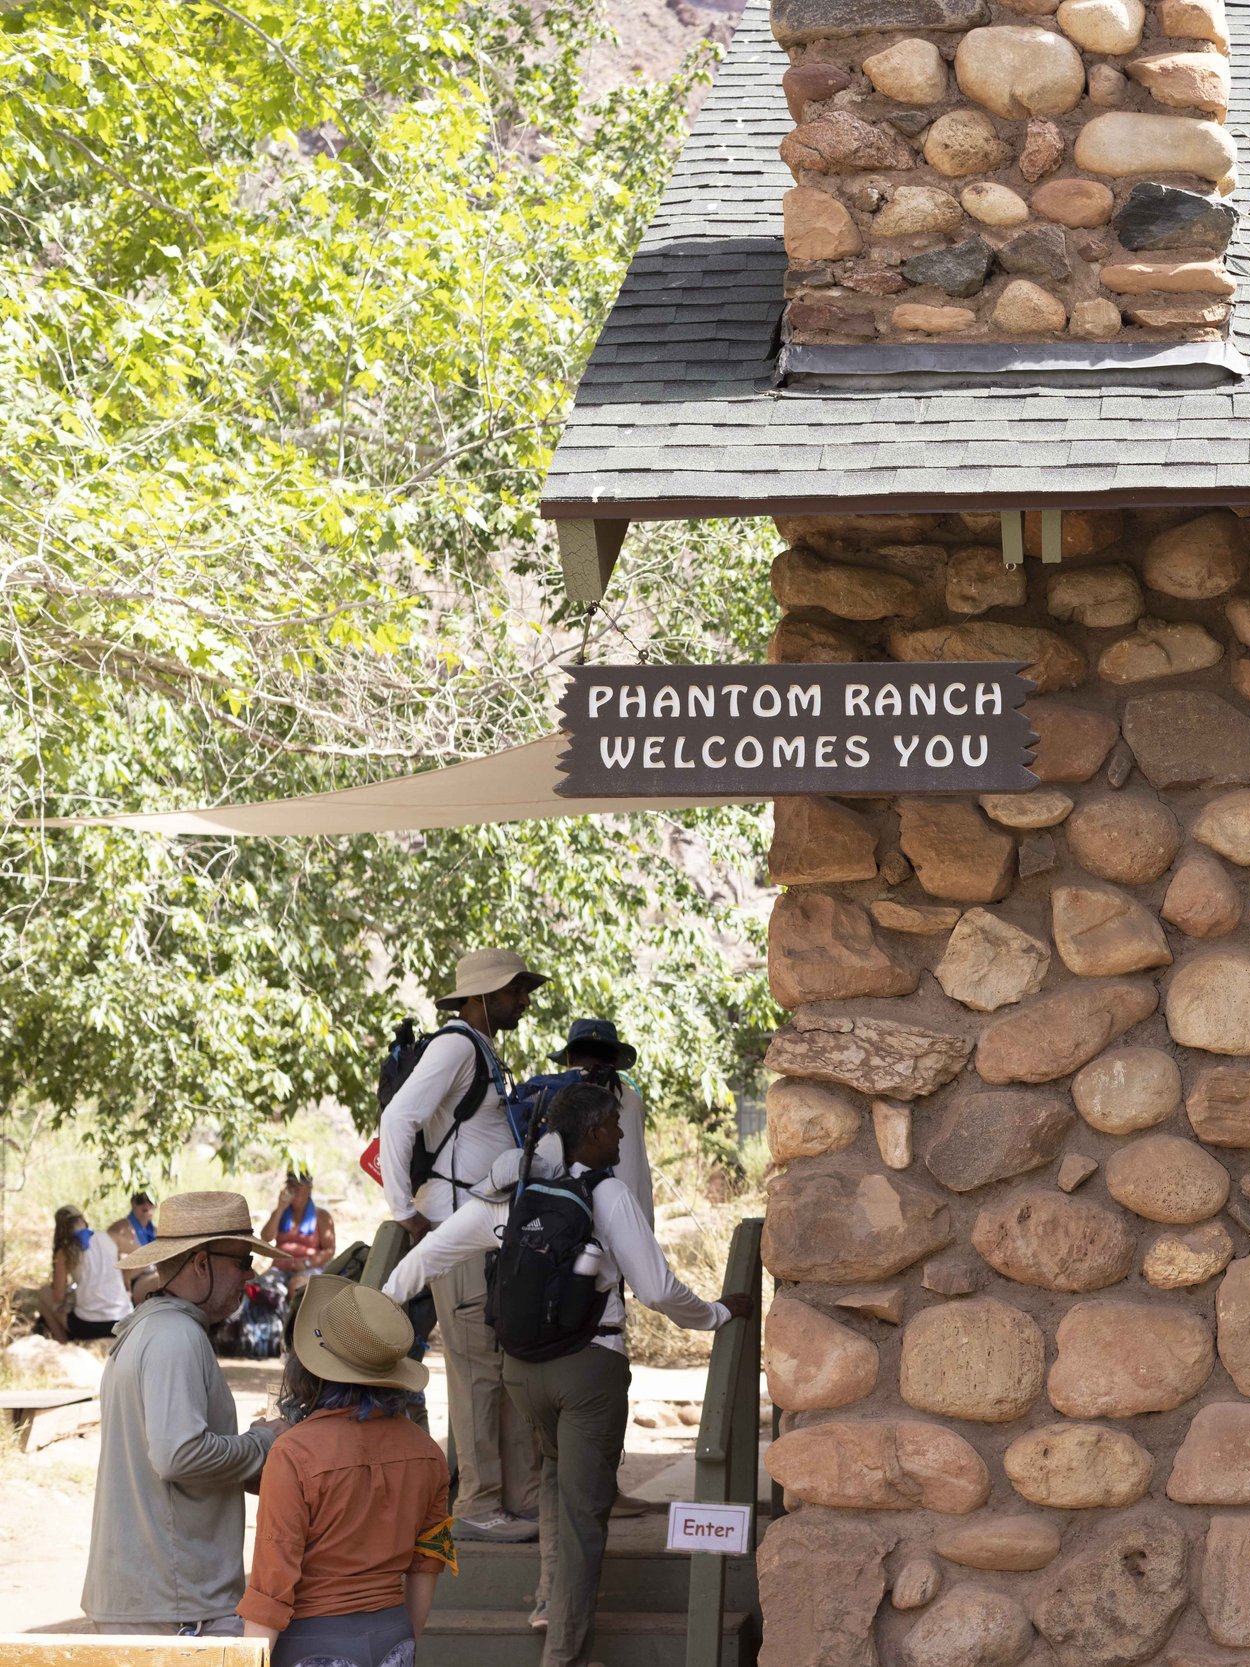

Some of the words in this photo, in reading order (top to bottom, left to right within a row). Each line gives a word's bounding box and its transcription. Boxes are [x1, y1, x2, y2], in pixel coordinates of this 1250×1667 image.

[588, 683, 822, 718] PHANTOM
[844, 682, 1003, 717] RANCH
[599, 734, 870, 770] WELCOMES
[892, 734, 989, 768] YOU
[683, 1518, 735, 1538] Enter
